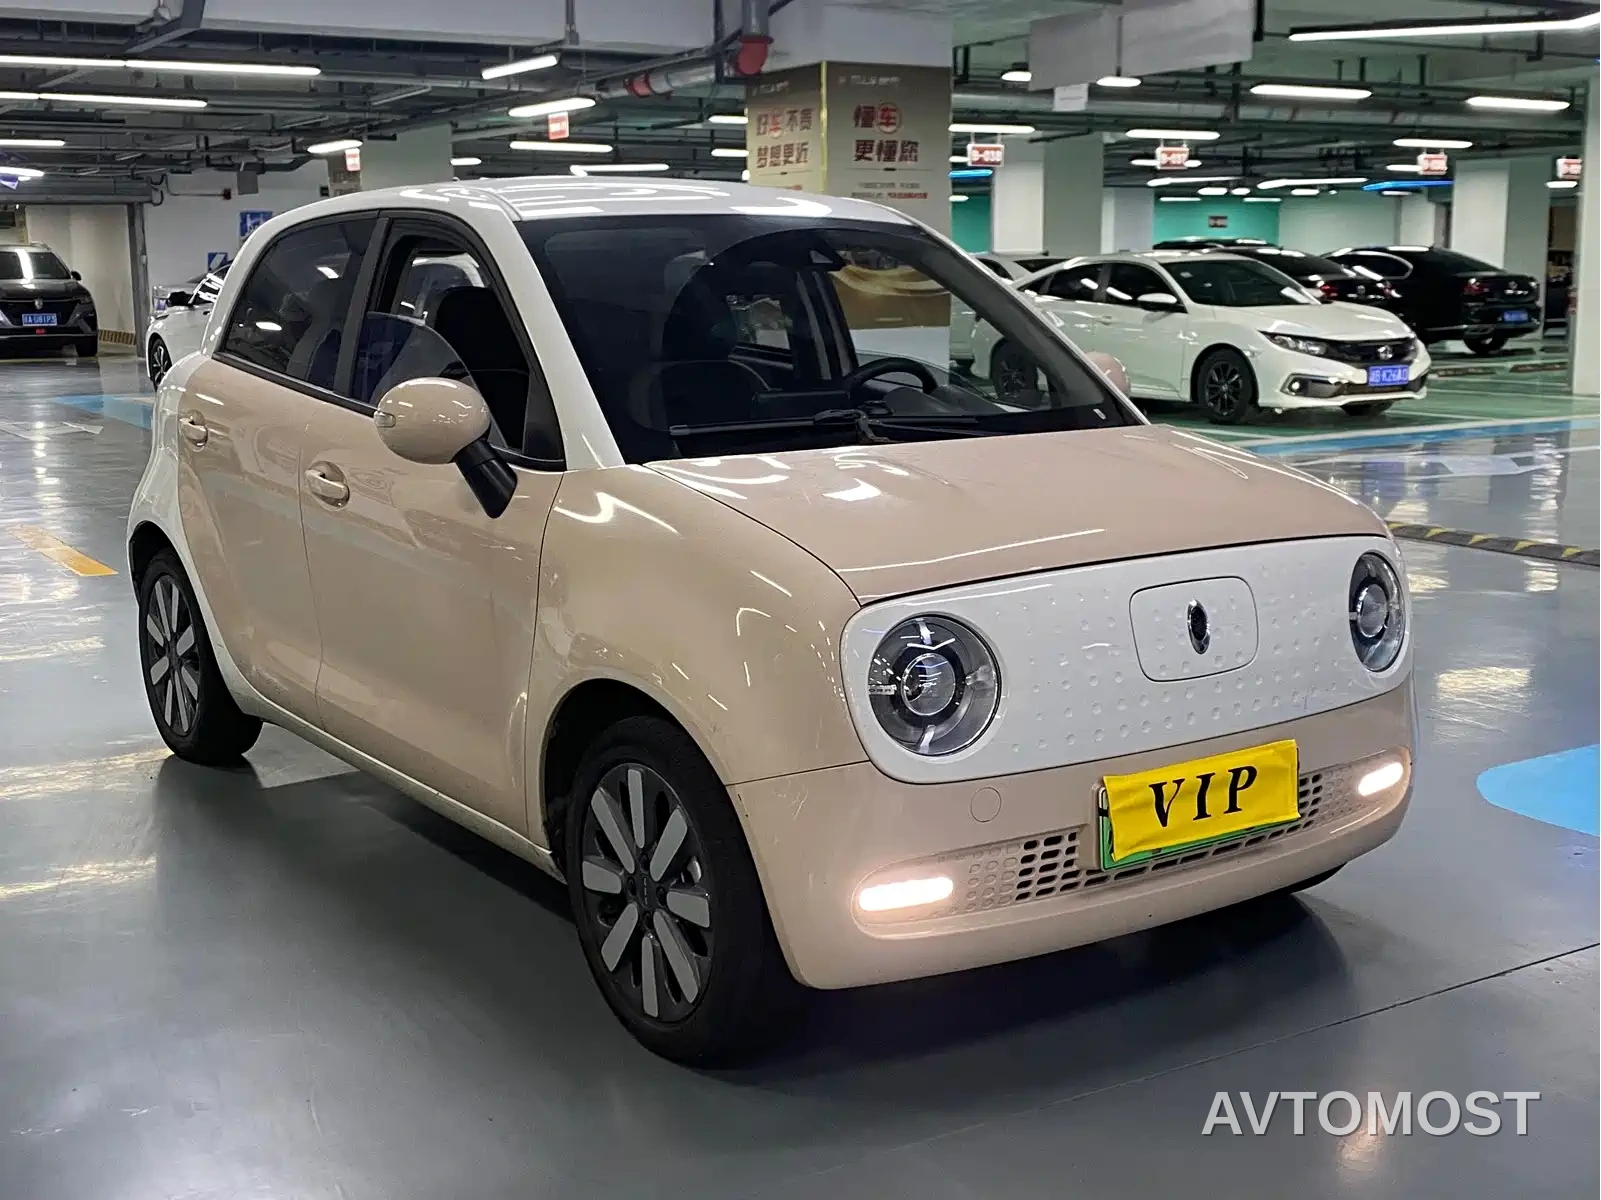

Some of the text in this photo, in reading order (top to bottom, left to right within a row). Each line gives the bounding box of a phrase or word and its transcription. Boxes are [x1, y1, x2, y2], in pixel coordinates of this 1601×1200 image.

[853, 103, 901, 131] 懂车
[756, 142, 809, 168] 梦想更近
[853, 140, 919, 162] 更懂您
[1148, 765, 1258, 828] VIP
